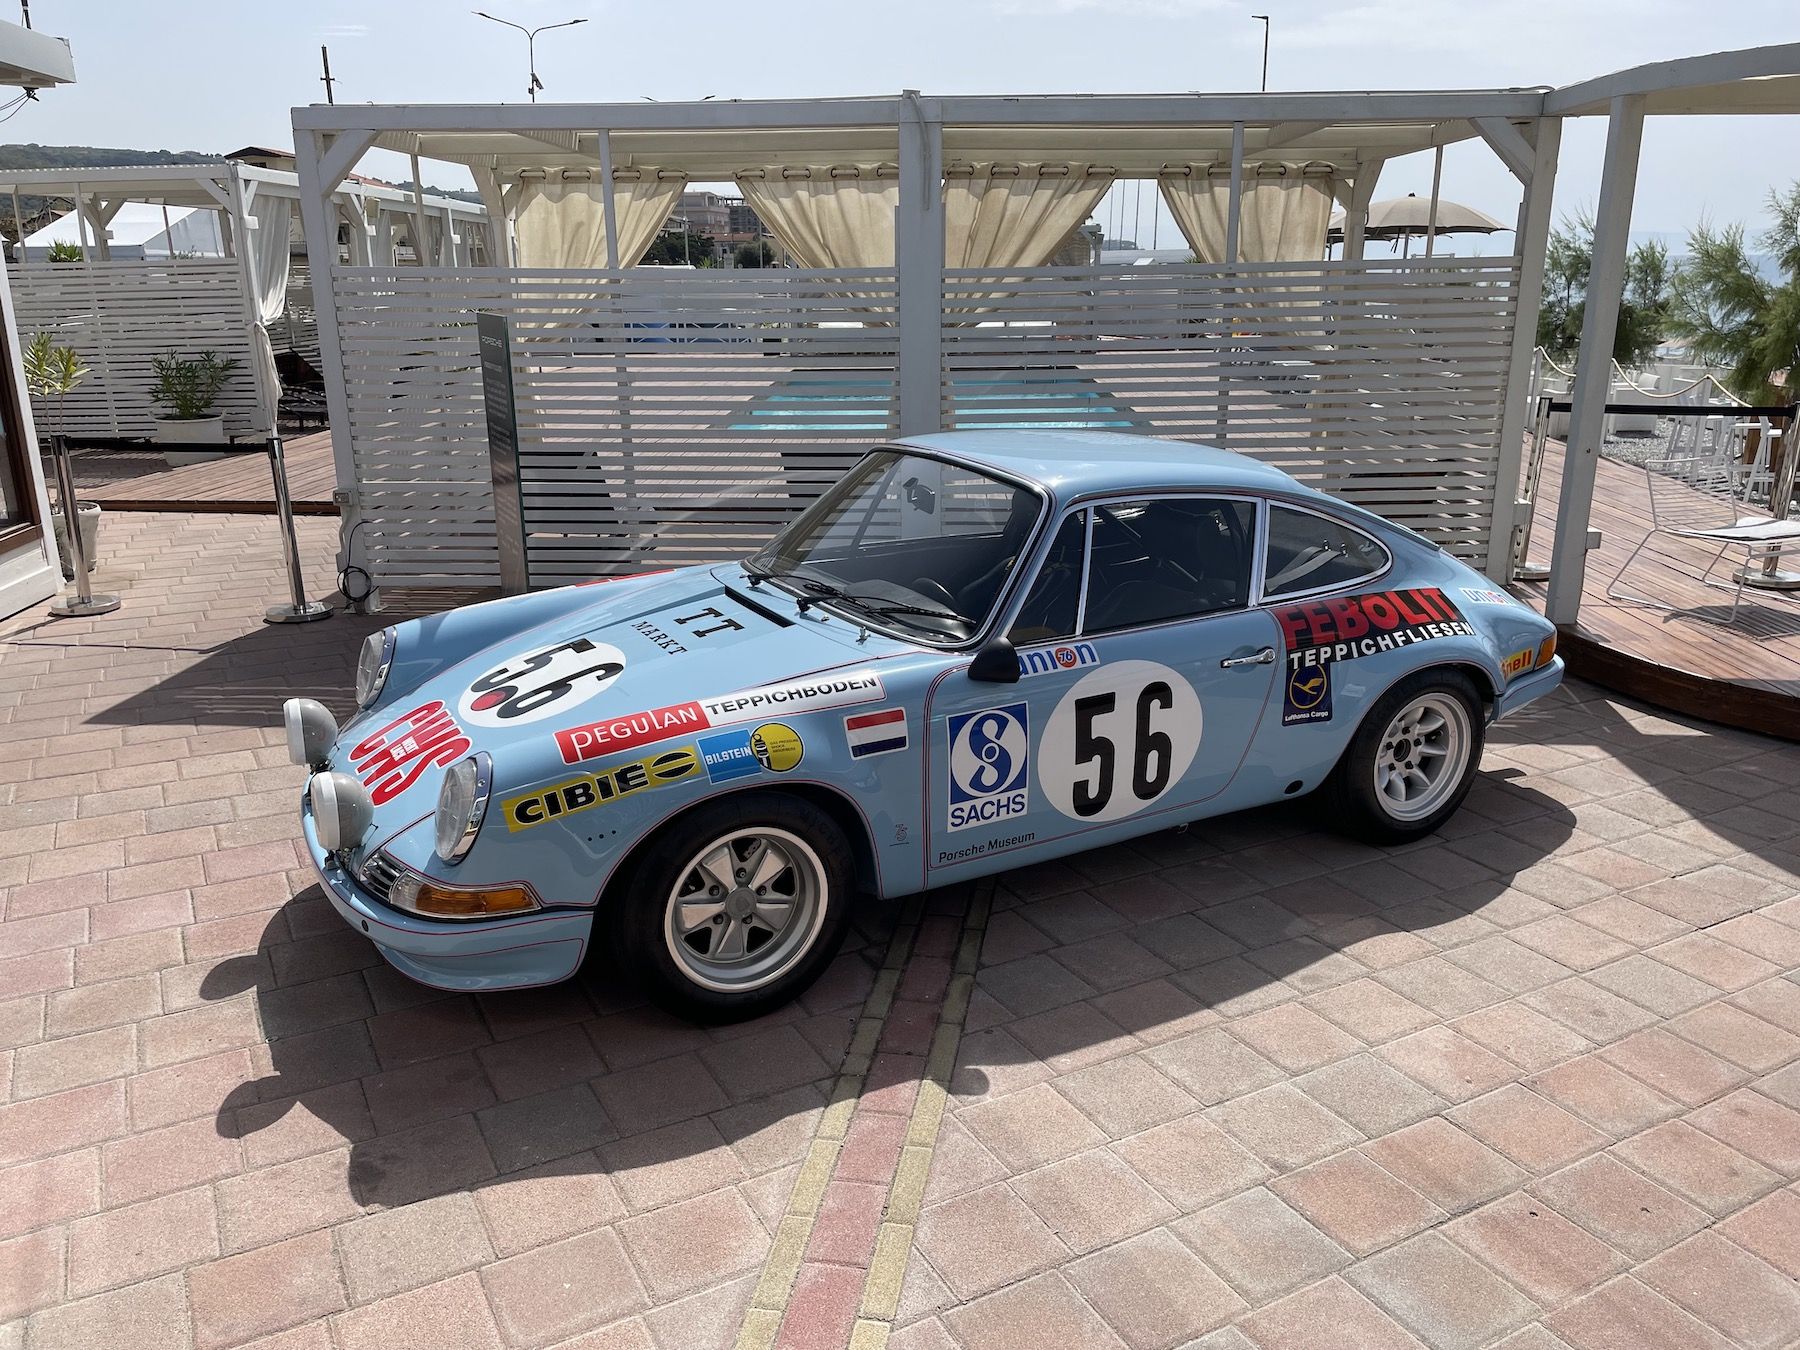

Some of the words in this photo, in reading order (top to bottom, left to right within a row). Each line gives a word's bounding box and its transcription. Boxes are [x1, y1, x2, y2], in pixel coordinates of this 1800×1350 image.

[632, 621, 688, 655] MARKT
[1274, 587, 1460, 650] FEBOLIT
[1059, 650, 1073, 662] 76
[1289, 621, 1476, 670] TEPPICHFLIESEN
[470, 638, 625, 719] 56
[570, 707, 699, 762] PEGULAN
[705, 675, 878, 716] TEPPICHBODEN
[348, 700, 472, 807] CWS
[705, 746, 753, 766] BILSTEIN
[1072, 681, 1173, 817] 56
[950, 793, 1026, 828] SACHS
[939, 844, 985, 863] Porsche
[987, 832, 1035, 851] Museum
